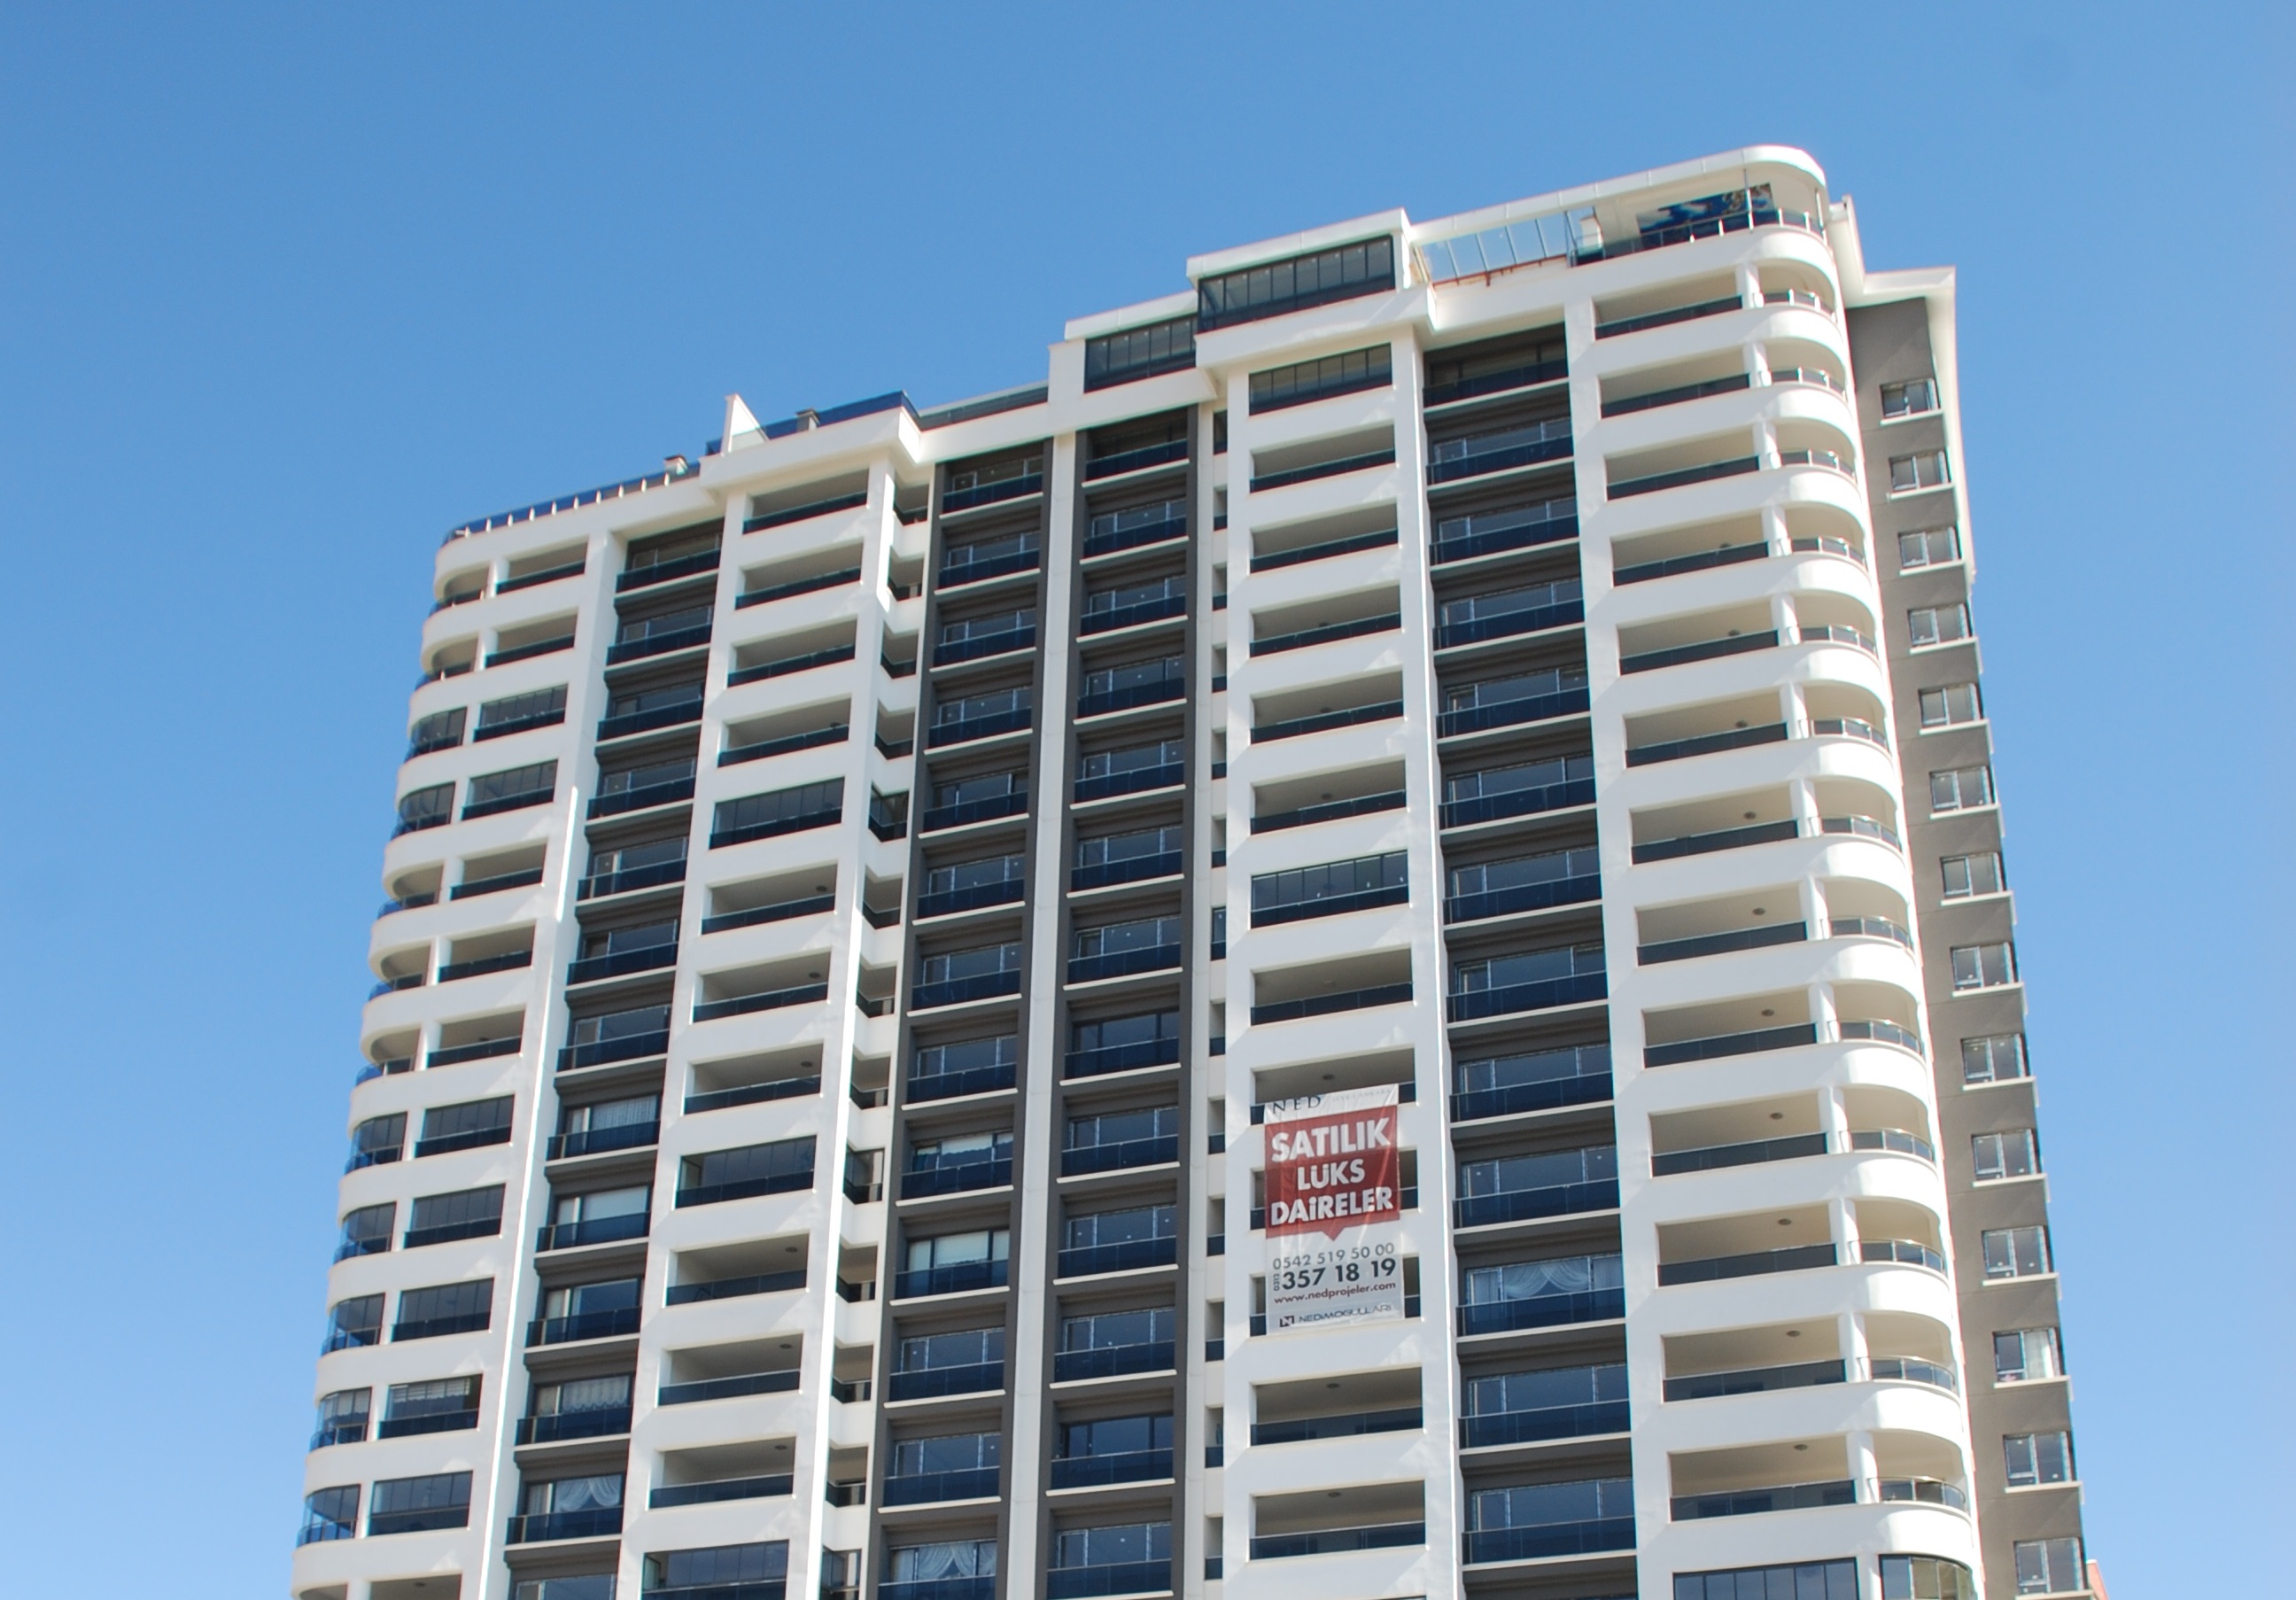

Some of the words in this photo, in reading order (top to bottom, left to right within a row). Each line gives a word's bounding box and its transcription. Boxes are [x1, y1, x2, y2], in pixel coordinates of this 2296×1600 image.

[1272, 1095, 1322, 1114] NED
[1271, 1117, 1392, 1162] SATILIK
[1273, 1254, 1311, 1270] 0542
[1316, 1249, 1346, 1264] 519
[1351, 1247, 1370, 1259] 50
[1375, 1242, 1394, 1255] 00
[1283, 1267, 1326, 1290] 357
[1335, 1262, 1360, 1283] 18
[1371, 1258, 1396, 1278] 19
[1274, 1281, 1396, 1305] www.nedprojeler.com
